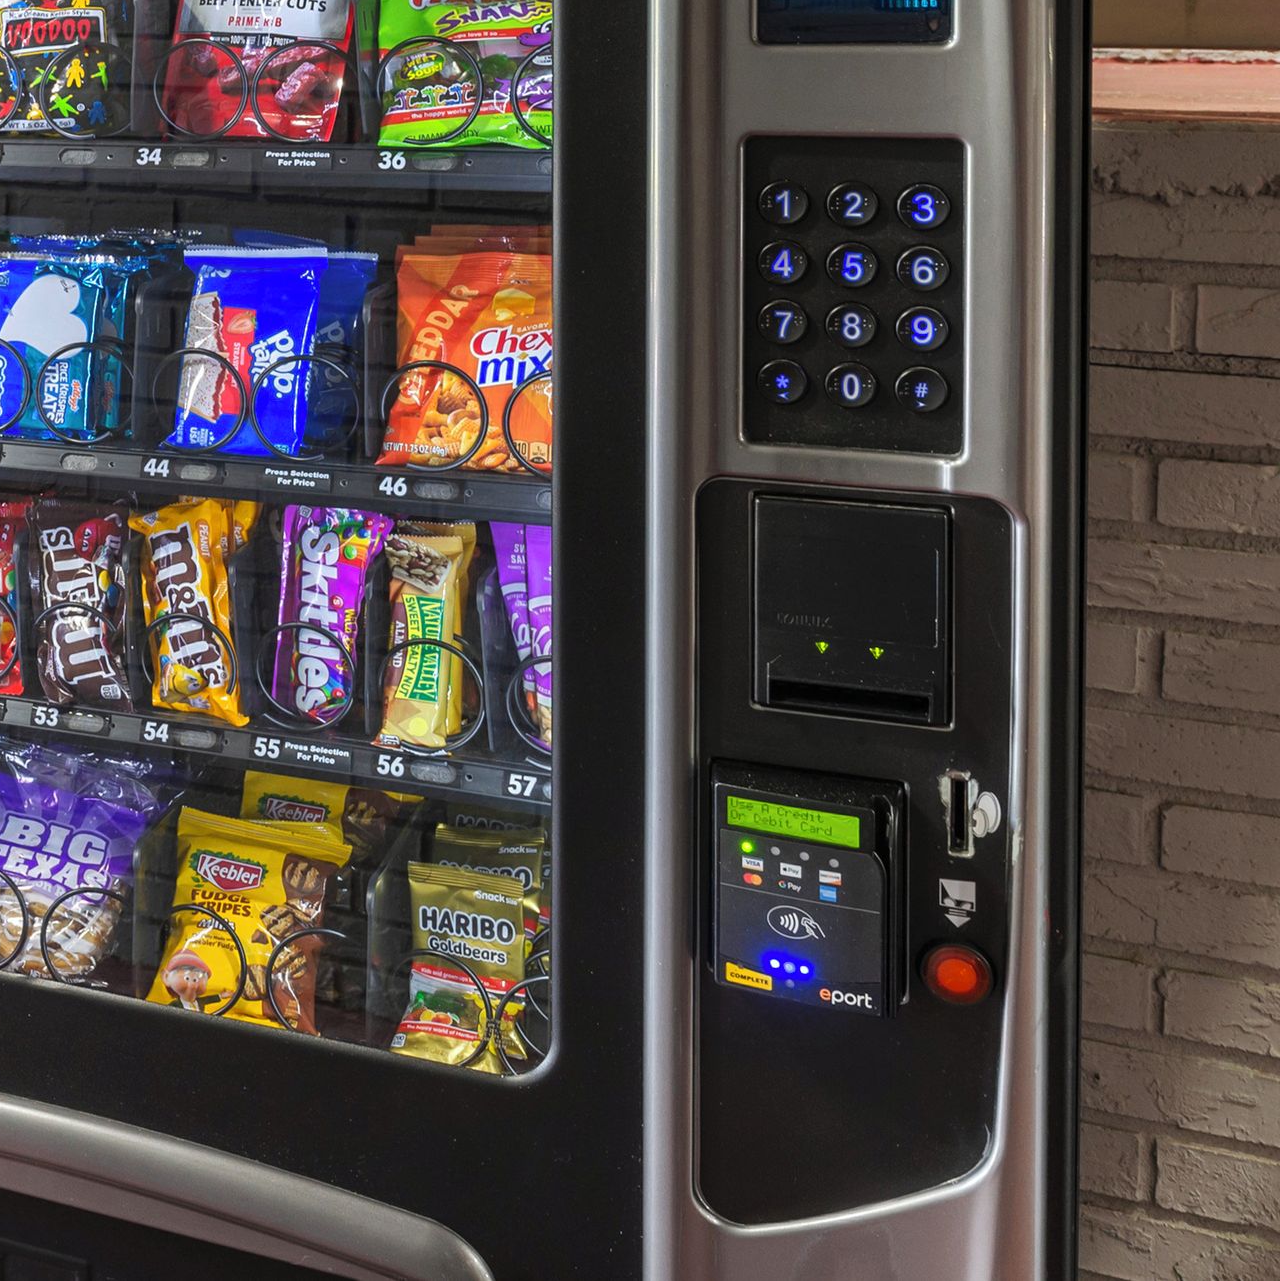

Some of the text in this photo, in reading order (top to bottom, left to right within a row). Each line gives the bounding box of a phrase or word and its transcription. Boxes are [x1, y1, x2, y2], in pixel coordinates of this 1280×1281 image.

[7, 18, 93, 49] VOODOO
[227, 16, 260, 28] PRIME
[136, 148, 162, 166] 34
[265, 151, 330, 160] Press Selection
[278, 159, 316, 168] For Price
[378, 150, 406, 170] 36
[776, 189, 937, 223] 1 2 3
[773, 249, 935, 285] 4 5 6
[516, 322, 549, 334] SAVORY
[776, 312, 934, 347] 7 8 9
[473, 328, 552, 357] Chex
[478, 350, 552, 390] mix
[55, 361, 69, 425] RICE KRISPIES
[842, 373, 861, 401] 0
[143, 458, 170, 477] 44
[265, 468, 330, 480] Press Selection
[277, 477, 316, 488] For Price
[379, 476, 408, 497] 46
[197, 523, 210, 558] PEANUT
[296, 524, 340, 712] Skittles
[396, 596, 420, 699] SWEET SALTY NUT
[412, 598, 443, 701] NATURE VALLEY
[34, 707, 59, 728] 53
[143, 722, 169, 743] 54
[253, 736, 281, 759] 55
[284, 742, 350, 758] Press Selection
[296, 752, 336, 765] For Price
[377, 754, 405, 778] 56
[508, 773, 537, 798] 57
[267, 799, 325, 824] Keebler
[730, 797, 824, 824] Use A Credit
[730, 809, 833, 837] Or Debit Card
[0, 814, 110, 866] BIG
[498, 845, 526, 856] Snack
[200, 856, 260, 886] Keebler
[745, 859, 761, 868] VISA
[191, 888, 251, 905] FUDGE
[476, 889, 505, 905] Snack
[418, 905, 516, 946] HARIBO
[428, 936, 509, 966] Goldbears
[729, 971, 770, 986] COMPLETE
[819, 988, 874, 1010] eport
